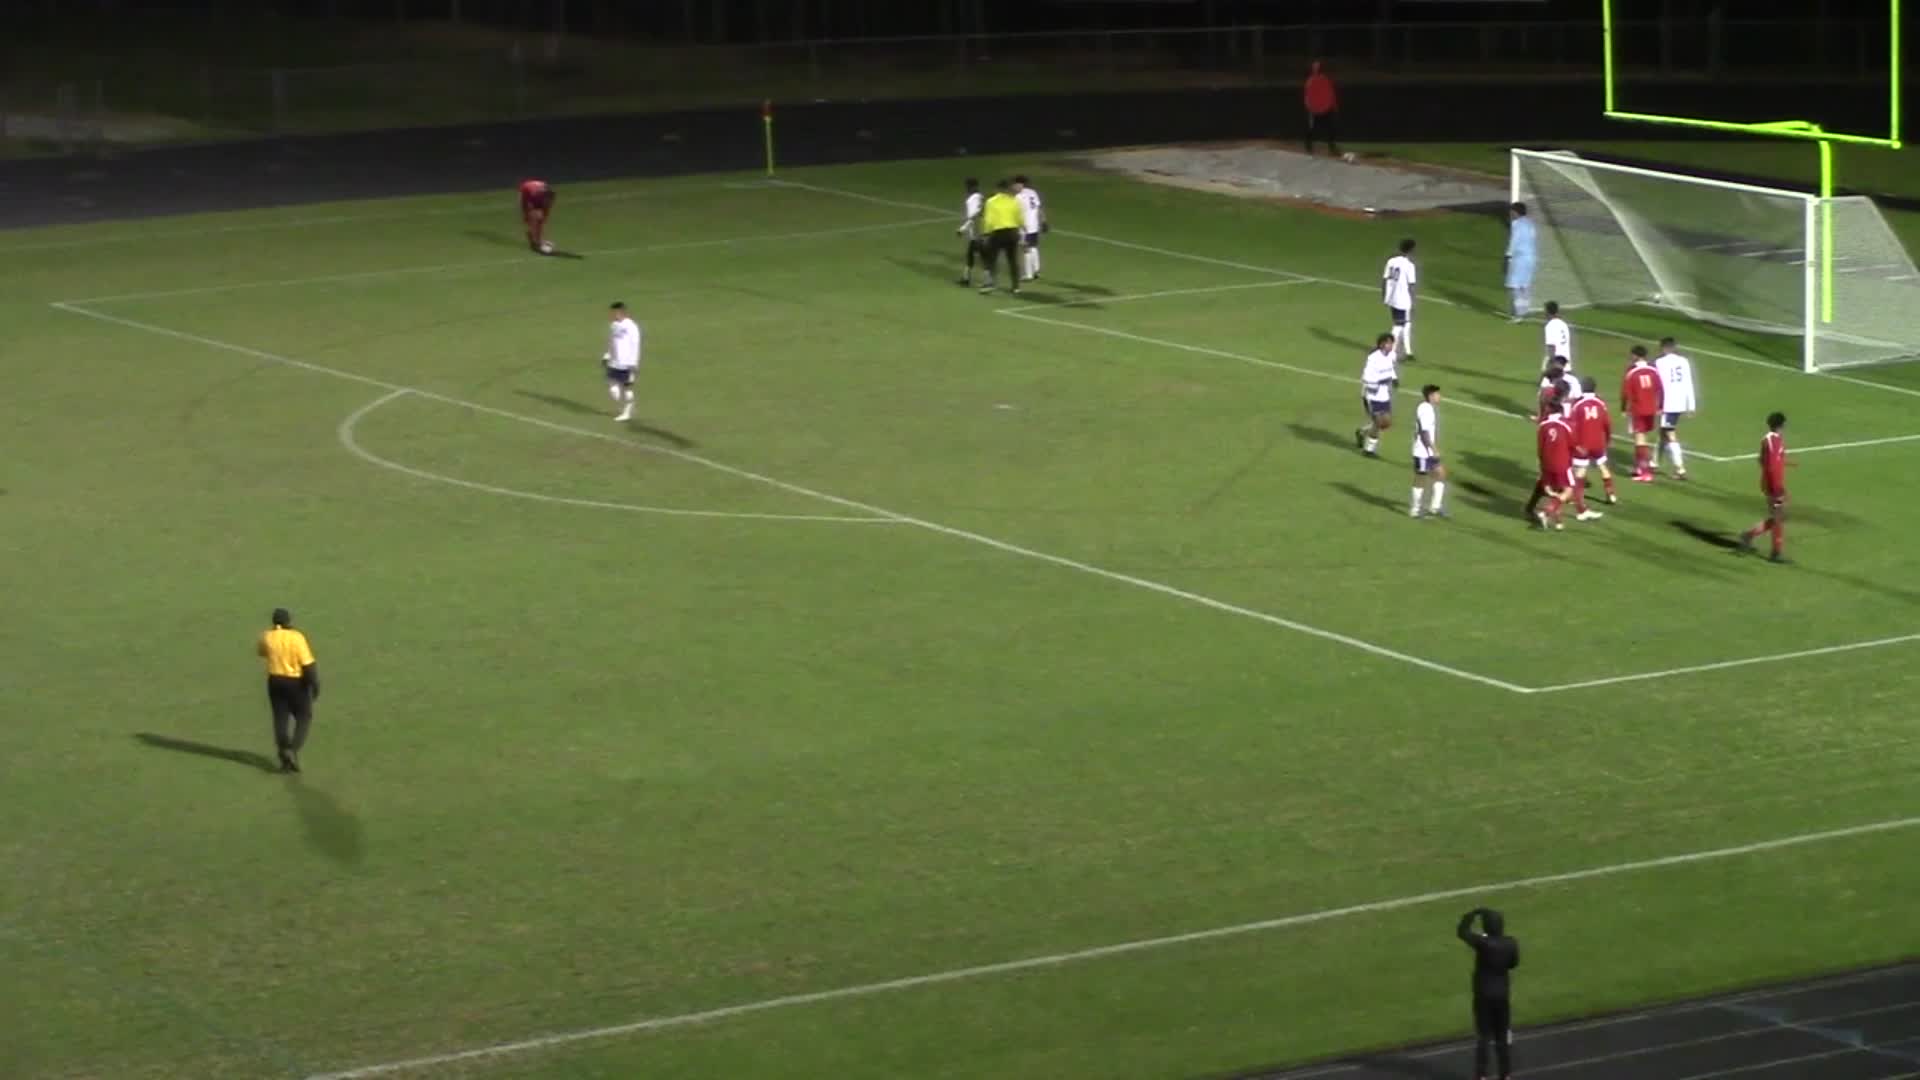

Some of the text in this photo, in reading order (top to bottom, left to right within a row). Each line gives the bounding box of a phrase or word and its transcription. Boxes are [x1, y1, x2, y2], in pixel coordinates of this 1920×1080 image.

[1670, 366, 1683, 383] 15
[1584, 406, 1598, 420] 14
[1549, 428, 1557, 442] 9
